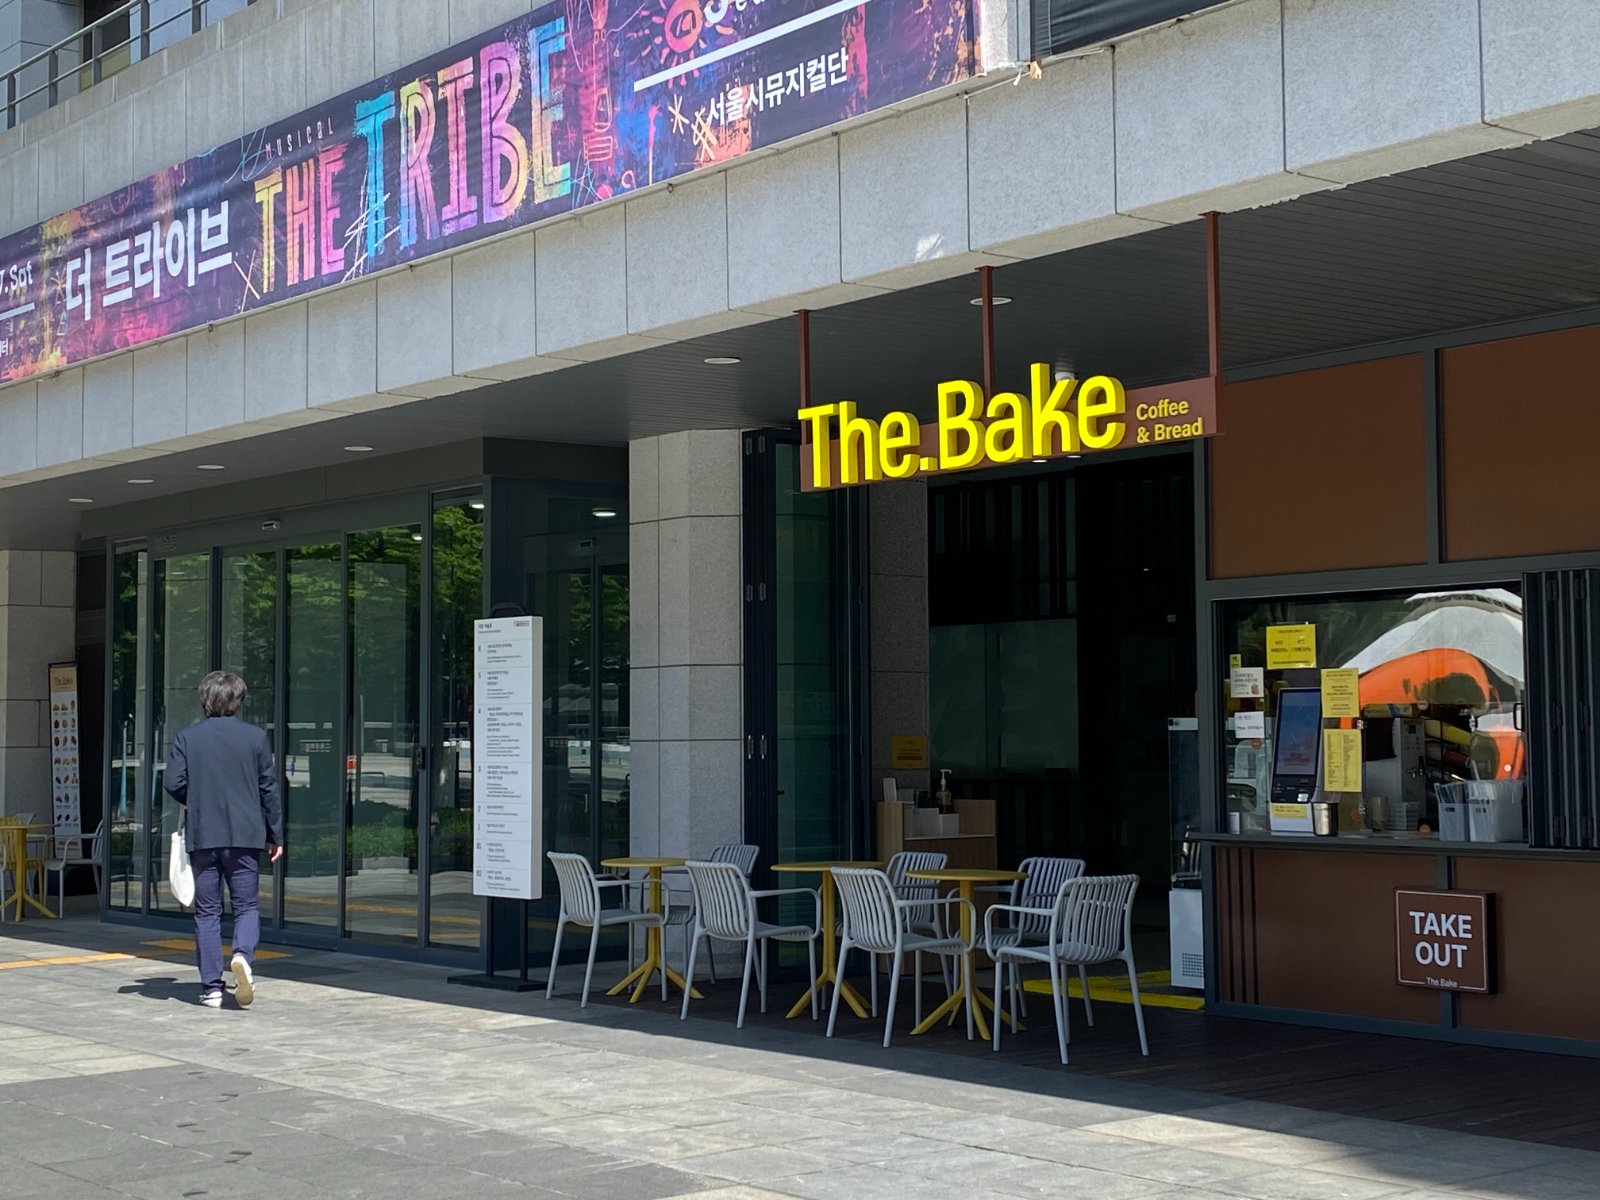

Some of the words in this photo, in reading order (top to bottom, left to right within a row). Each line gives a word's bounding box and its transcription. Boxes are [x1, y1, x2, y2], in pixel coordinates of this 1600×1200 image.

[707, 47, 848, 126] 서울시뮤지컬단
[254, 143, 348, 294] THE
[353, 16, 572, 258] TRIBE
[66, 247, 92, 321] 더
[102, 200, 233, 307] 트라이브
[1136, 398, 1190, 421] Coffee
[1136, 426, 1151, 444] &
[1154, 416, 1204, 441] Bread
[1409, 911, 1472, 938] TAKE
[1415, 941, 1467, 968] OUT
[1426, 976, 1440, 986] The
